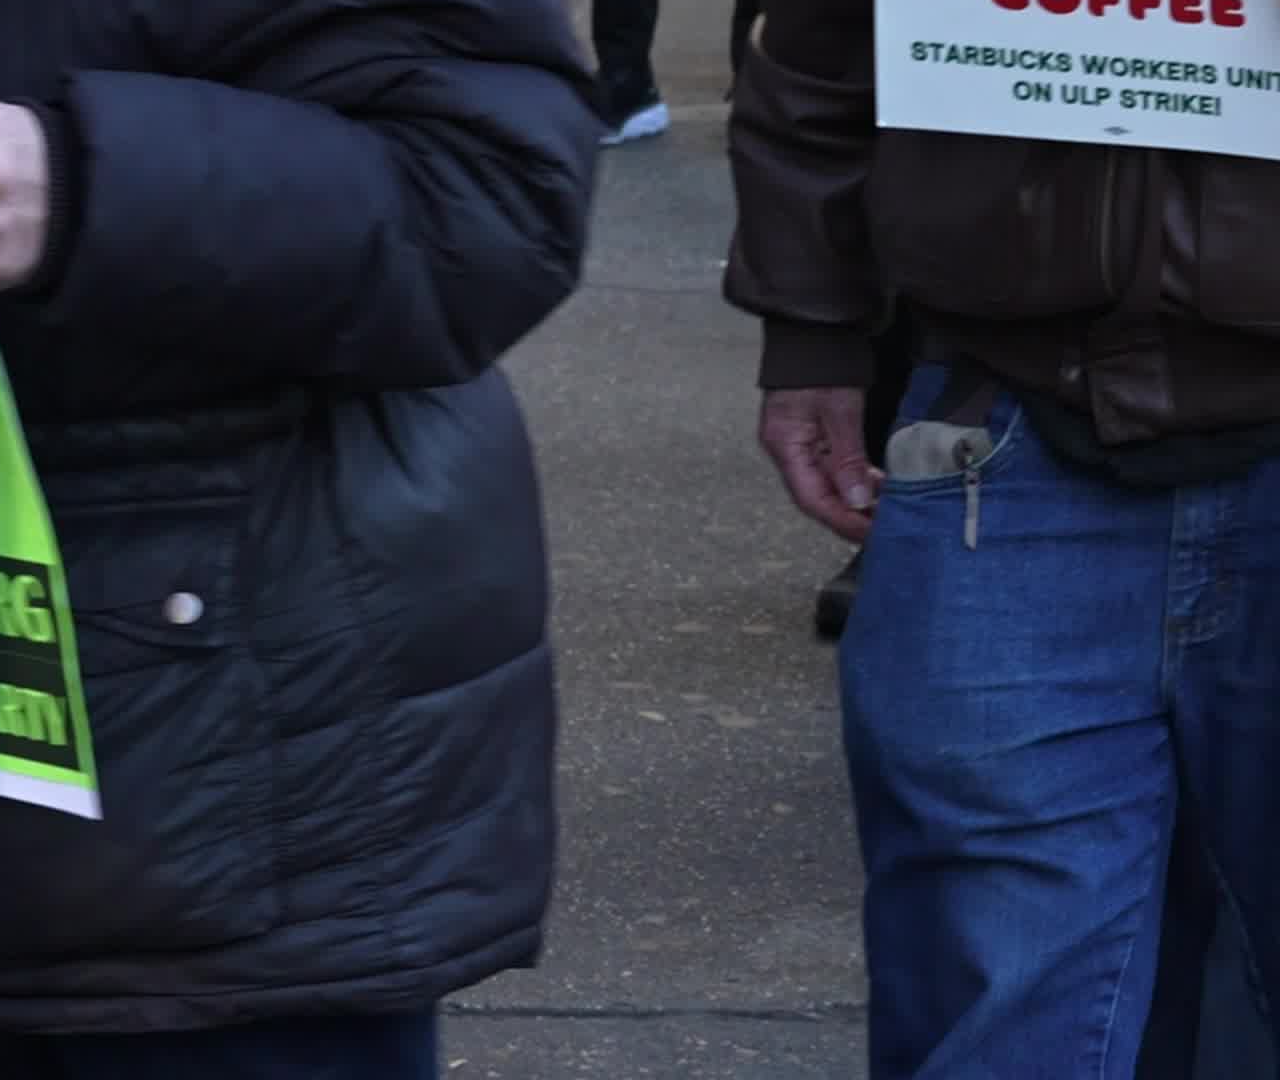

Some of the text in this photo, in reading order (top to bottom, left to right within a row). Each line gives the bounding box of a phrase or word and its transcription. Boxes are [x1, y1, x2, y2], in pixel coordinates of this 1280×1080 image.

[910, 42, 1072, 73] STARBUCKS
[1080, 54, 1219, 85] WORKERS
[1012, 81, 1221, 117] ON ULP STRIKE!
